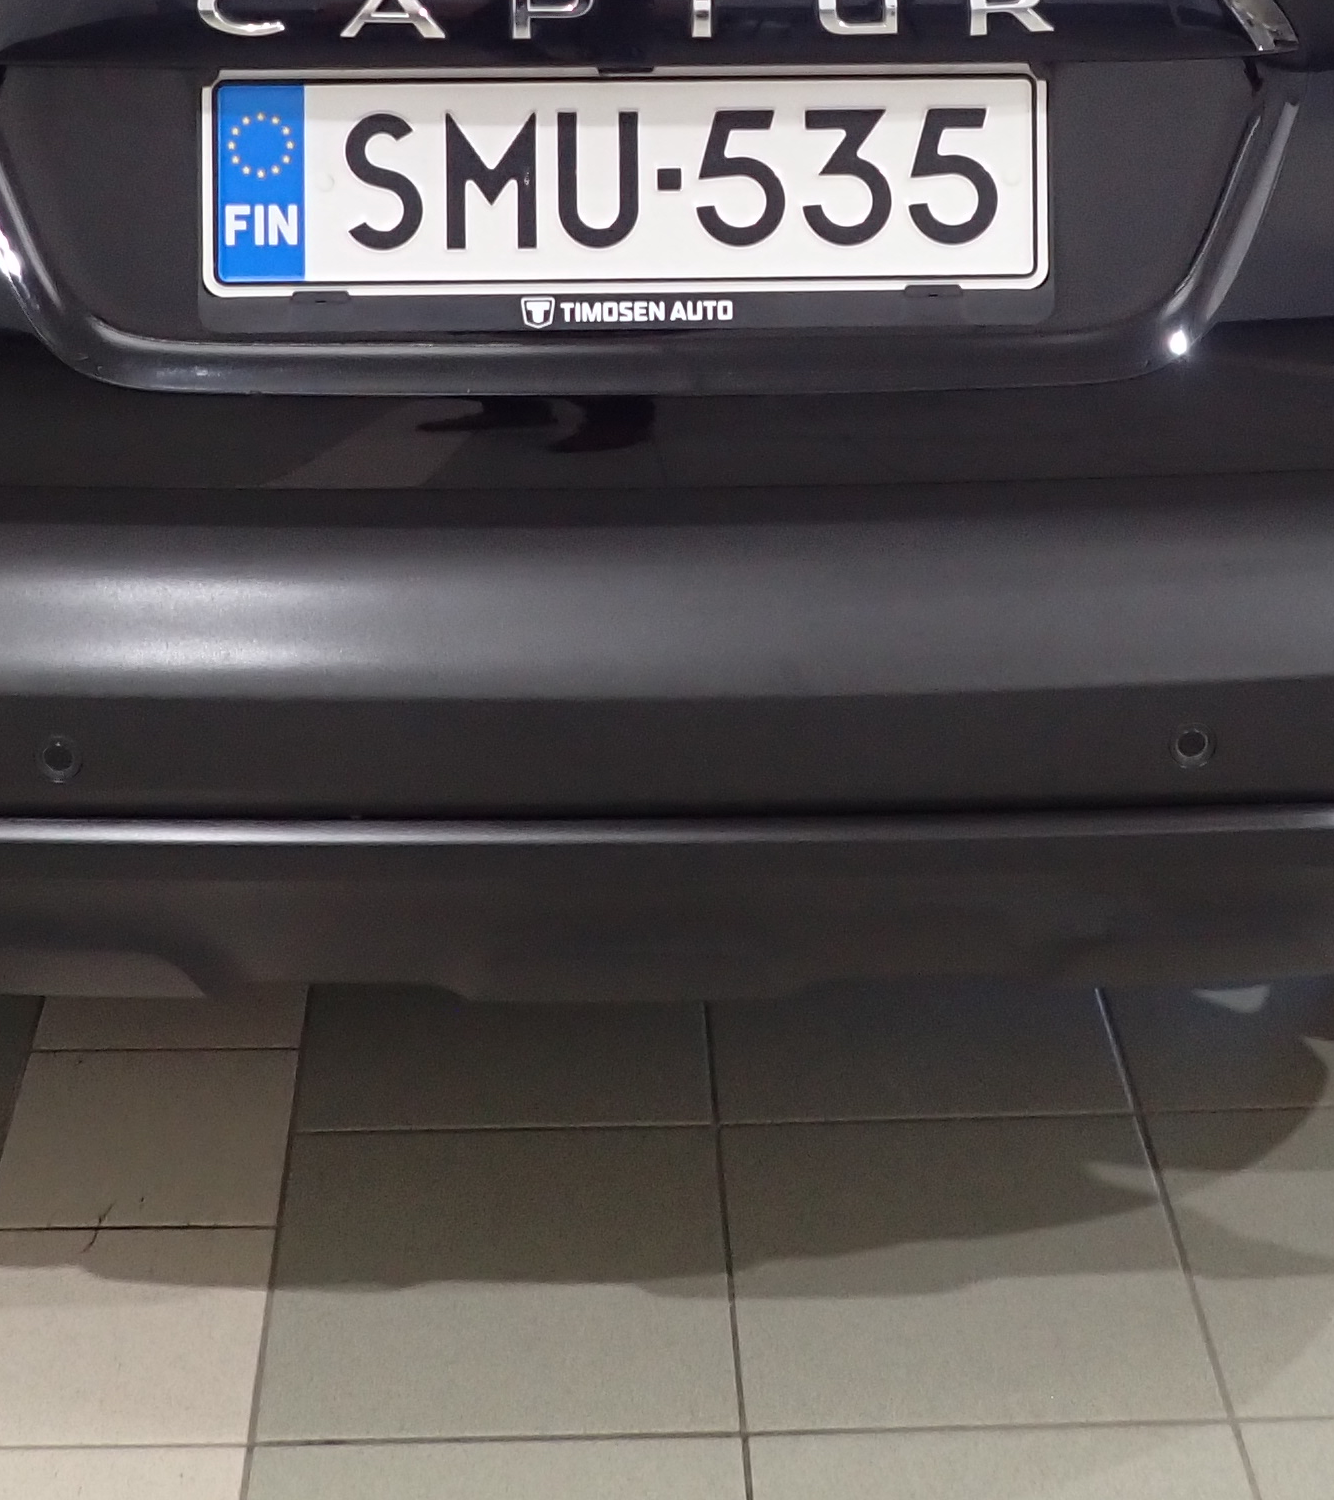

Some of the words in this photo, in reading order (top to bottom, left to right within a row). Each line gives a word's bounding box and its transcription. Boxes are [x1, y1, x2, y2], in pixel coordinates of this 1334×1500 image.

[343, 107, 999, 251] SMU-535
[224, 204, 299, 246] FIN
[560, 301, 666, 323] TIMOSEN
[669, 300, 734, 321] AUTO
